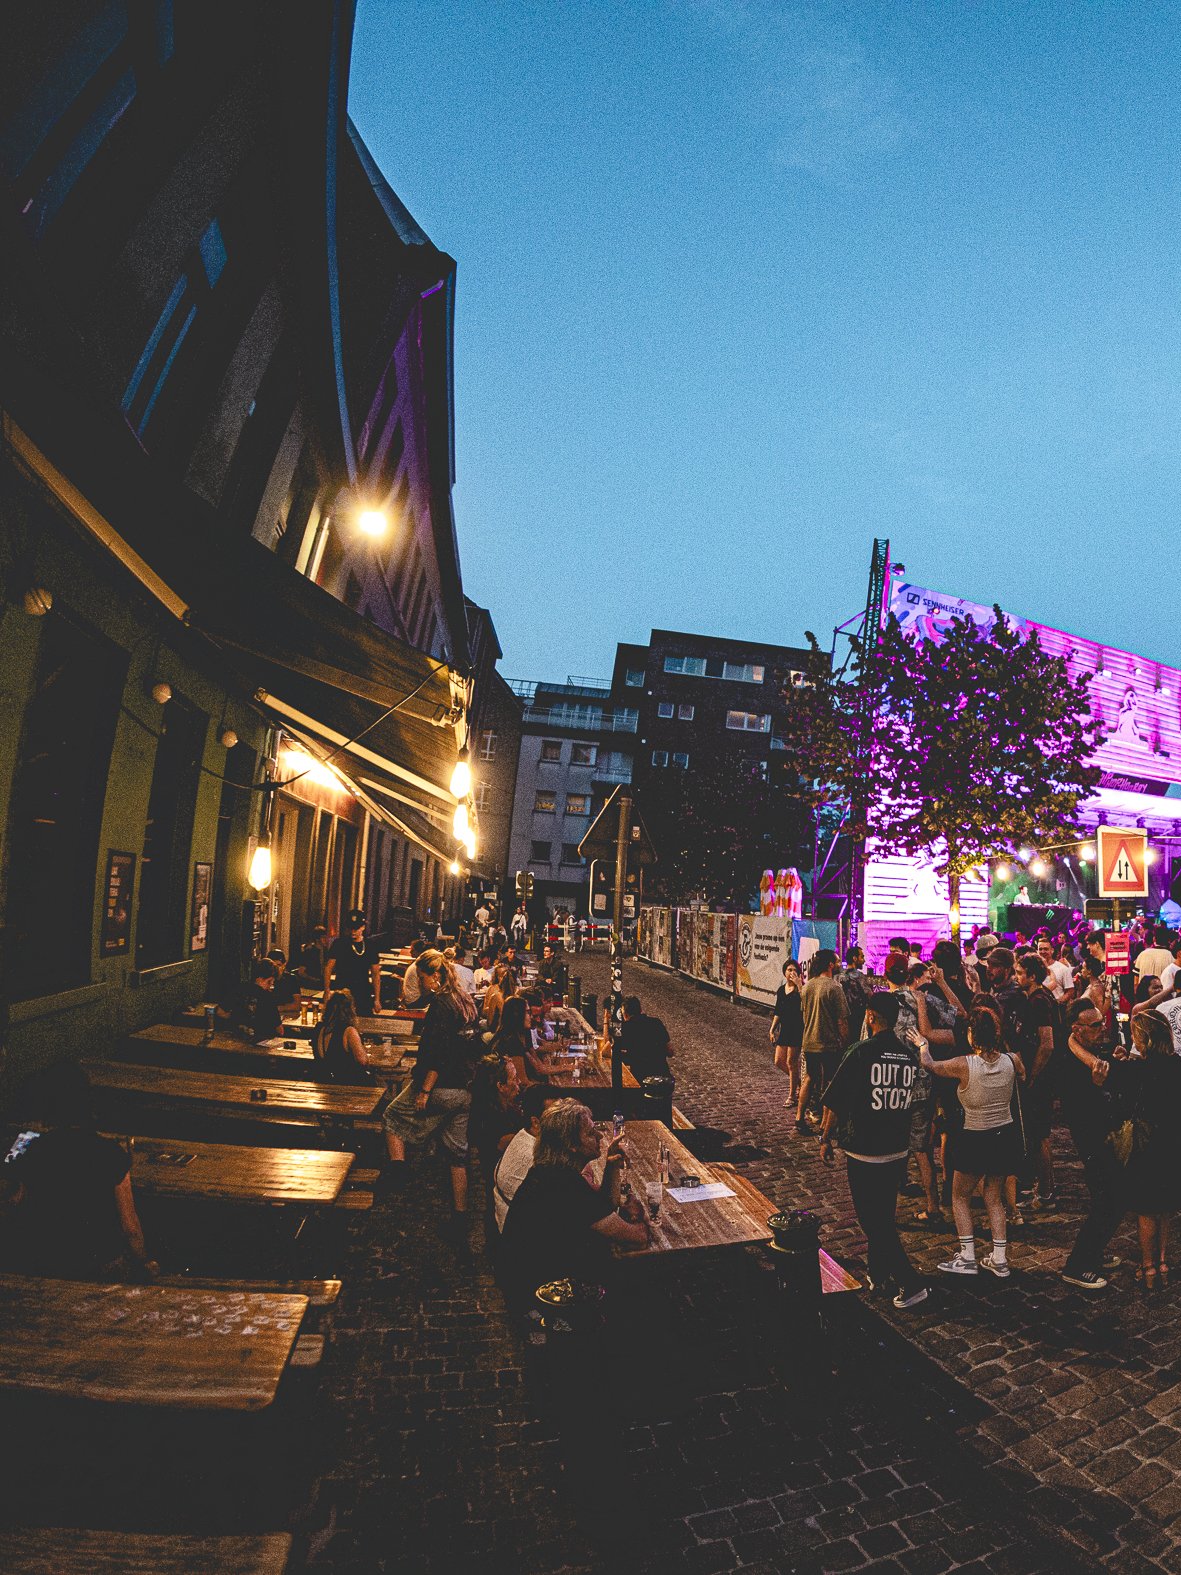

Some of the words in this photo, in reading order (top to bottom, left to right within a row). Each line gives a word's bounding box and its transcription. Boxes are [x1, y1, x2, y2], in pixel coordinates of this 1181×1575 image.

[922, 598, 965, 616] SENNHEISER
[870, 1062, 900, 1086] OUT
[903, 1065, 917, 1087] OF
[871, 1087, 912, 1110] STOCK
